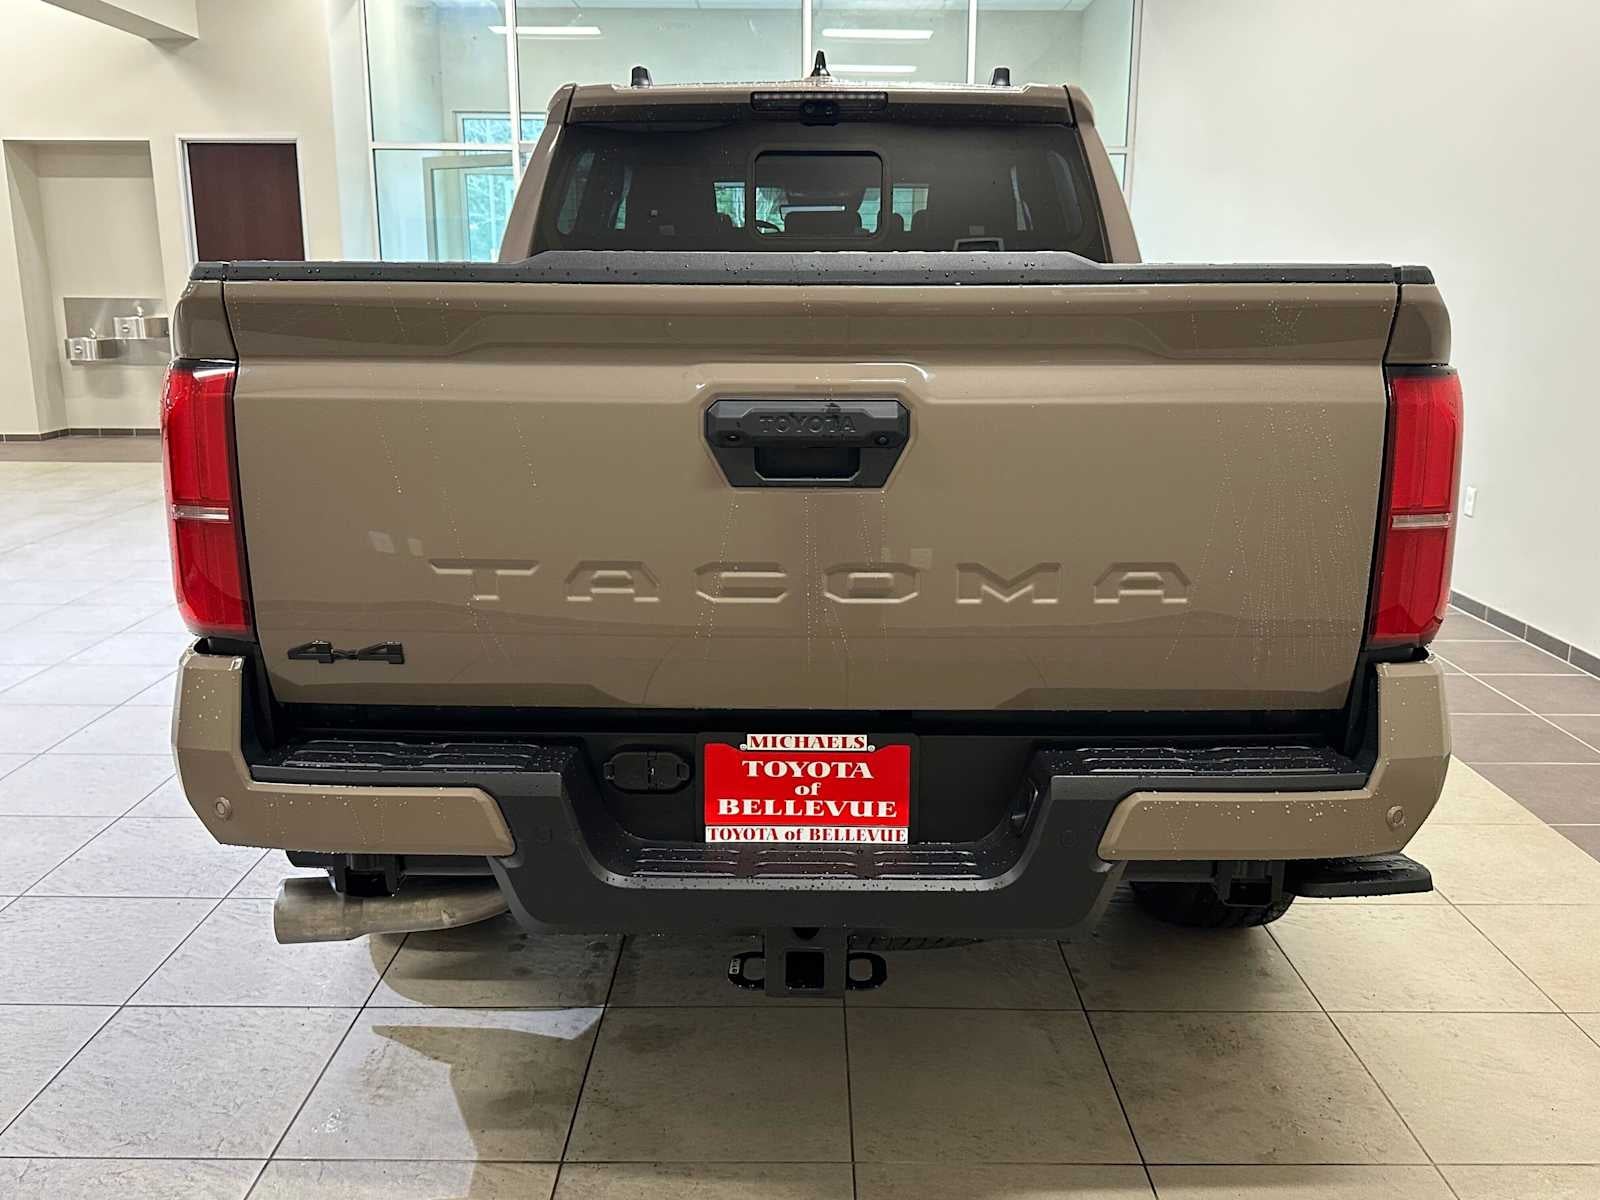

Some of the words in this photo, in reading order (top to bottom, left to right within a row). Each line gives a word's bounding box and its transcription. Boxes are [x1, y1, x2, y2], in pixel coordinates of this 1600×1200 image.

[760, 415, 857, 433] TOYOTA
[429, 558, 1192, 605] TACOMA
[750, 735, 865, 749] MICHAELS
[742, 760, 874, 779] TOYOTA
[794, 782, 821, 796] of
[717, 798, 897, 818] BELLEVUE
[707, 827, 779, 841] TOYOTA
[784, 829, 803, 841] of
[809, 828, 906, 842] BELLEVUE
